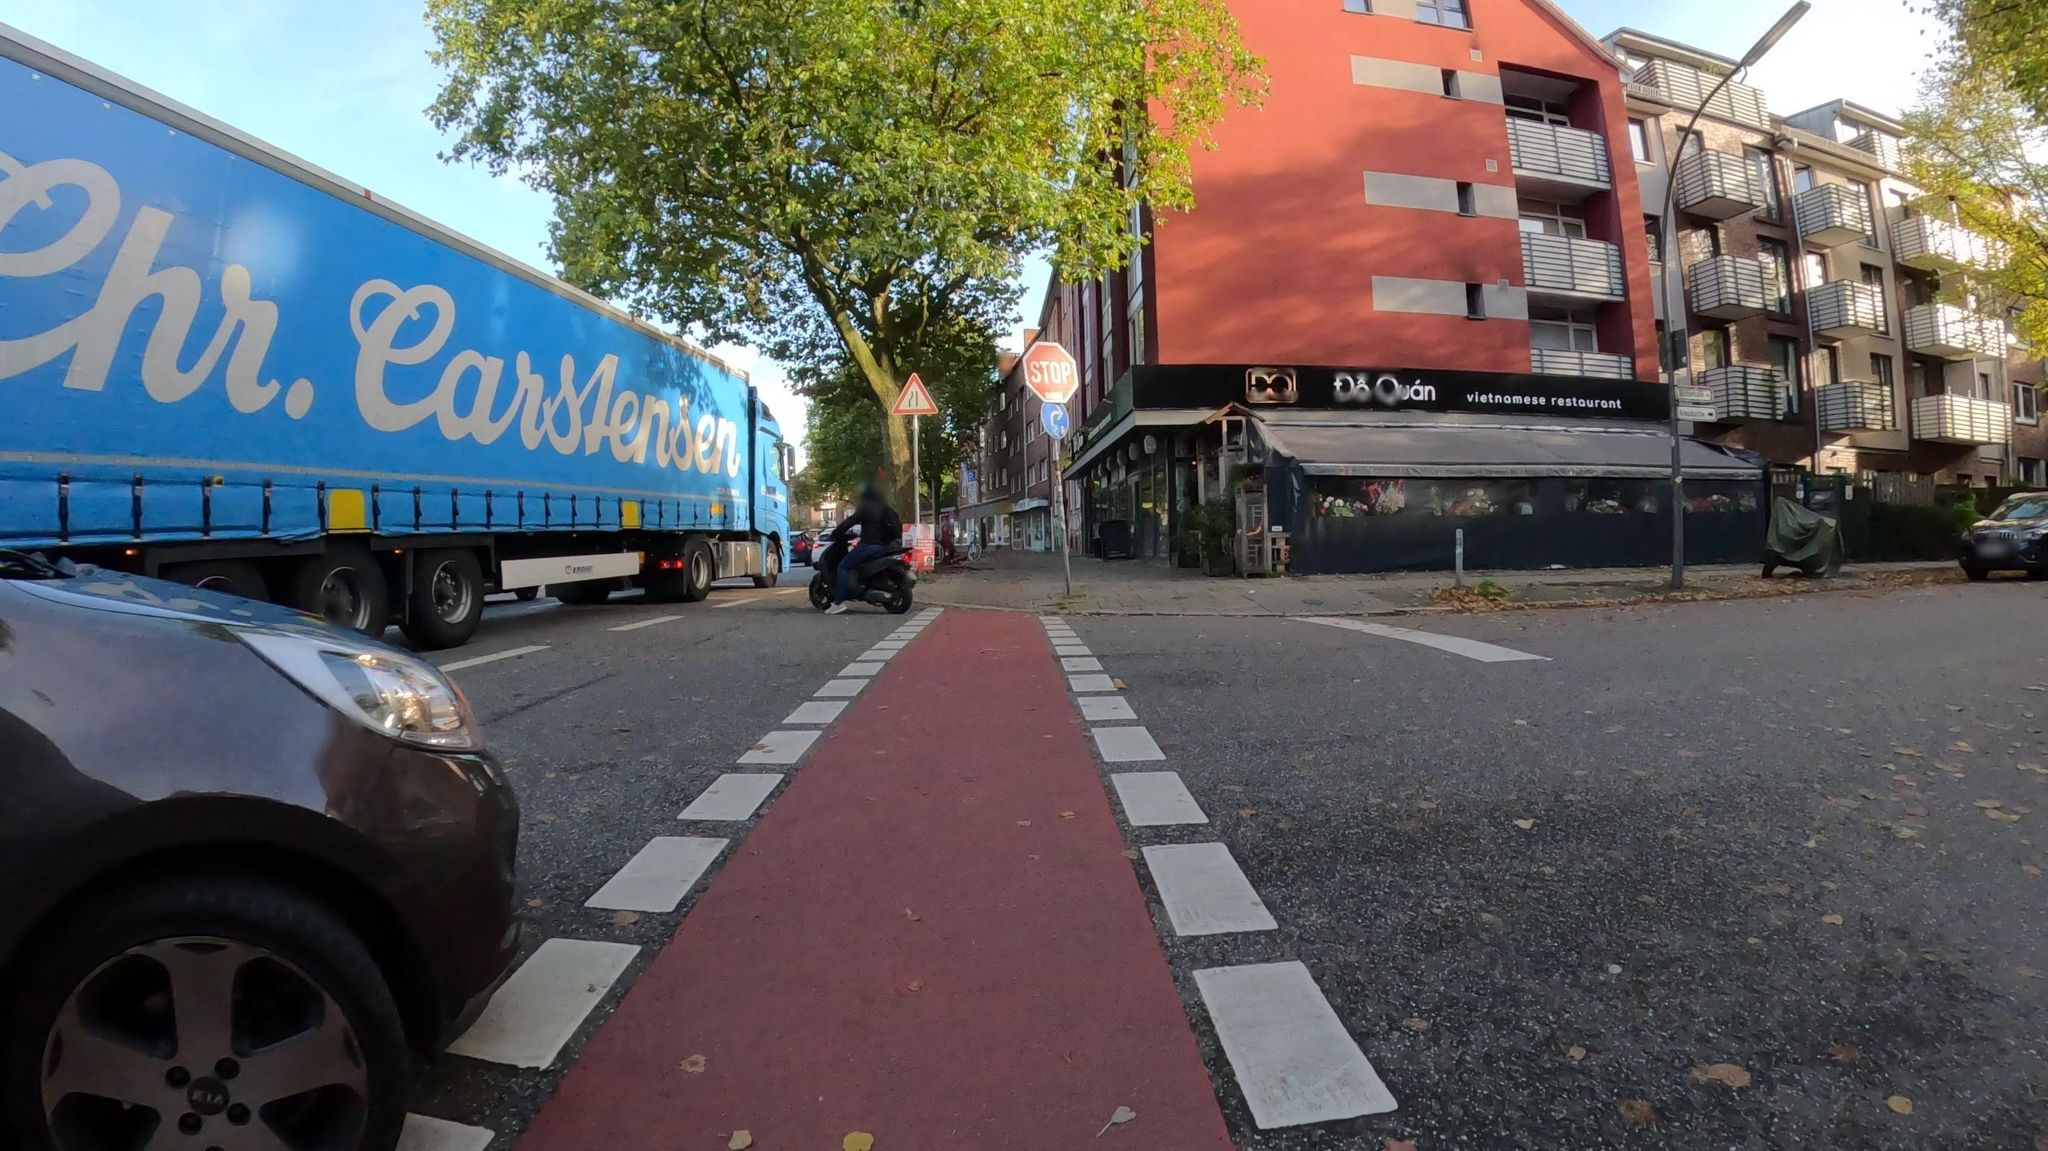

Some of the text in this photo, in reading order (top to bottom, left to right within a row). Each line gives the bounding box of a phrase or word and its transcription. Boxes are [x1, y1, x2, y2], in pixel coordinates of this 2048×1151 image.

[349, 278, 742, 478] Carstensen
[1030, 360, 1071, 385] STOP
[1466, 391, 1622, 409] vietnamese restaurant
